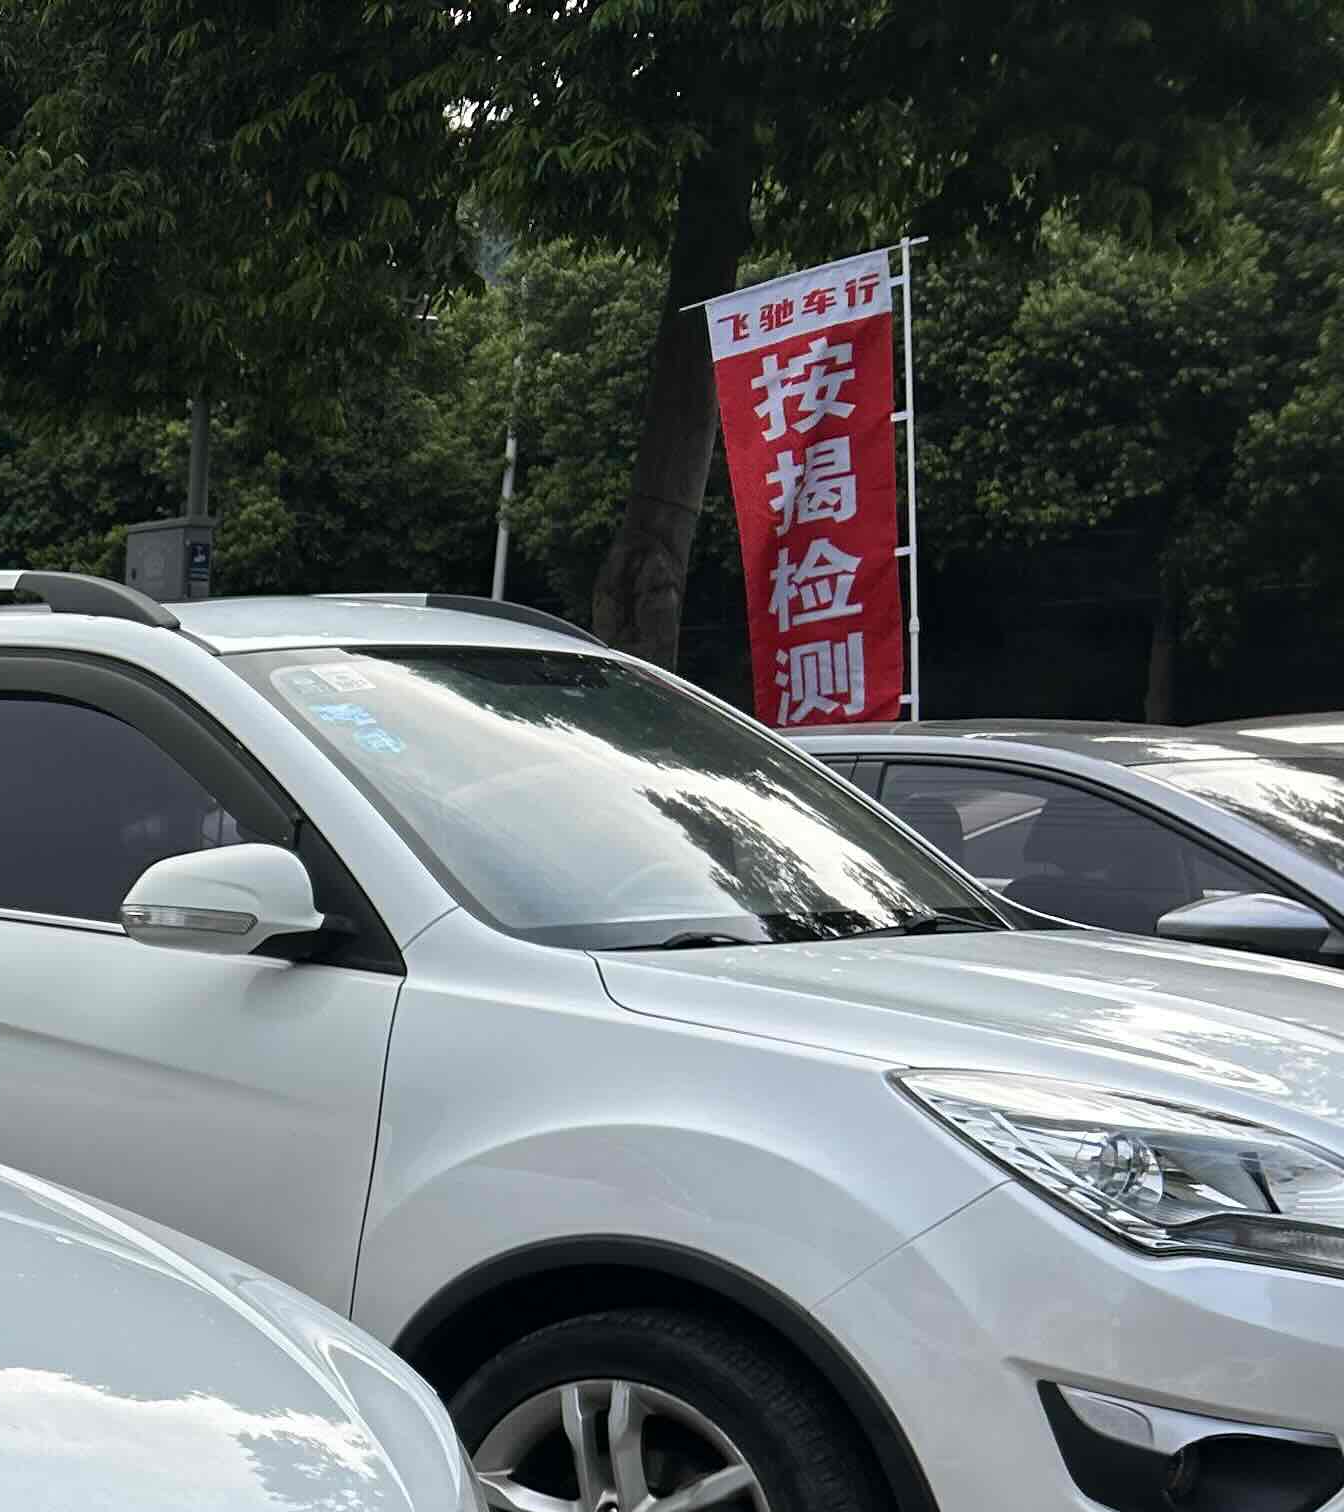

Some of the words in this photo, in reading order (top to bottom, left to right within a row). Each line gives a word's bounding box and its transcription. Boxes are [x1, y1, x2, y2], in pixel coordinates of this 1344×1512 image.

[717, 273, 880, 342] 飞驰车行
[751, 336, 865, 726] 按揭检测
